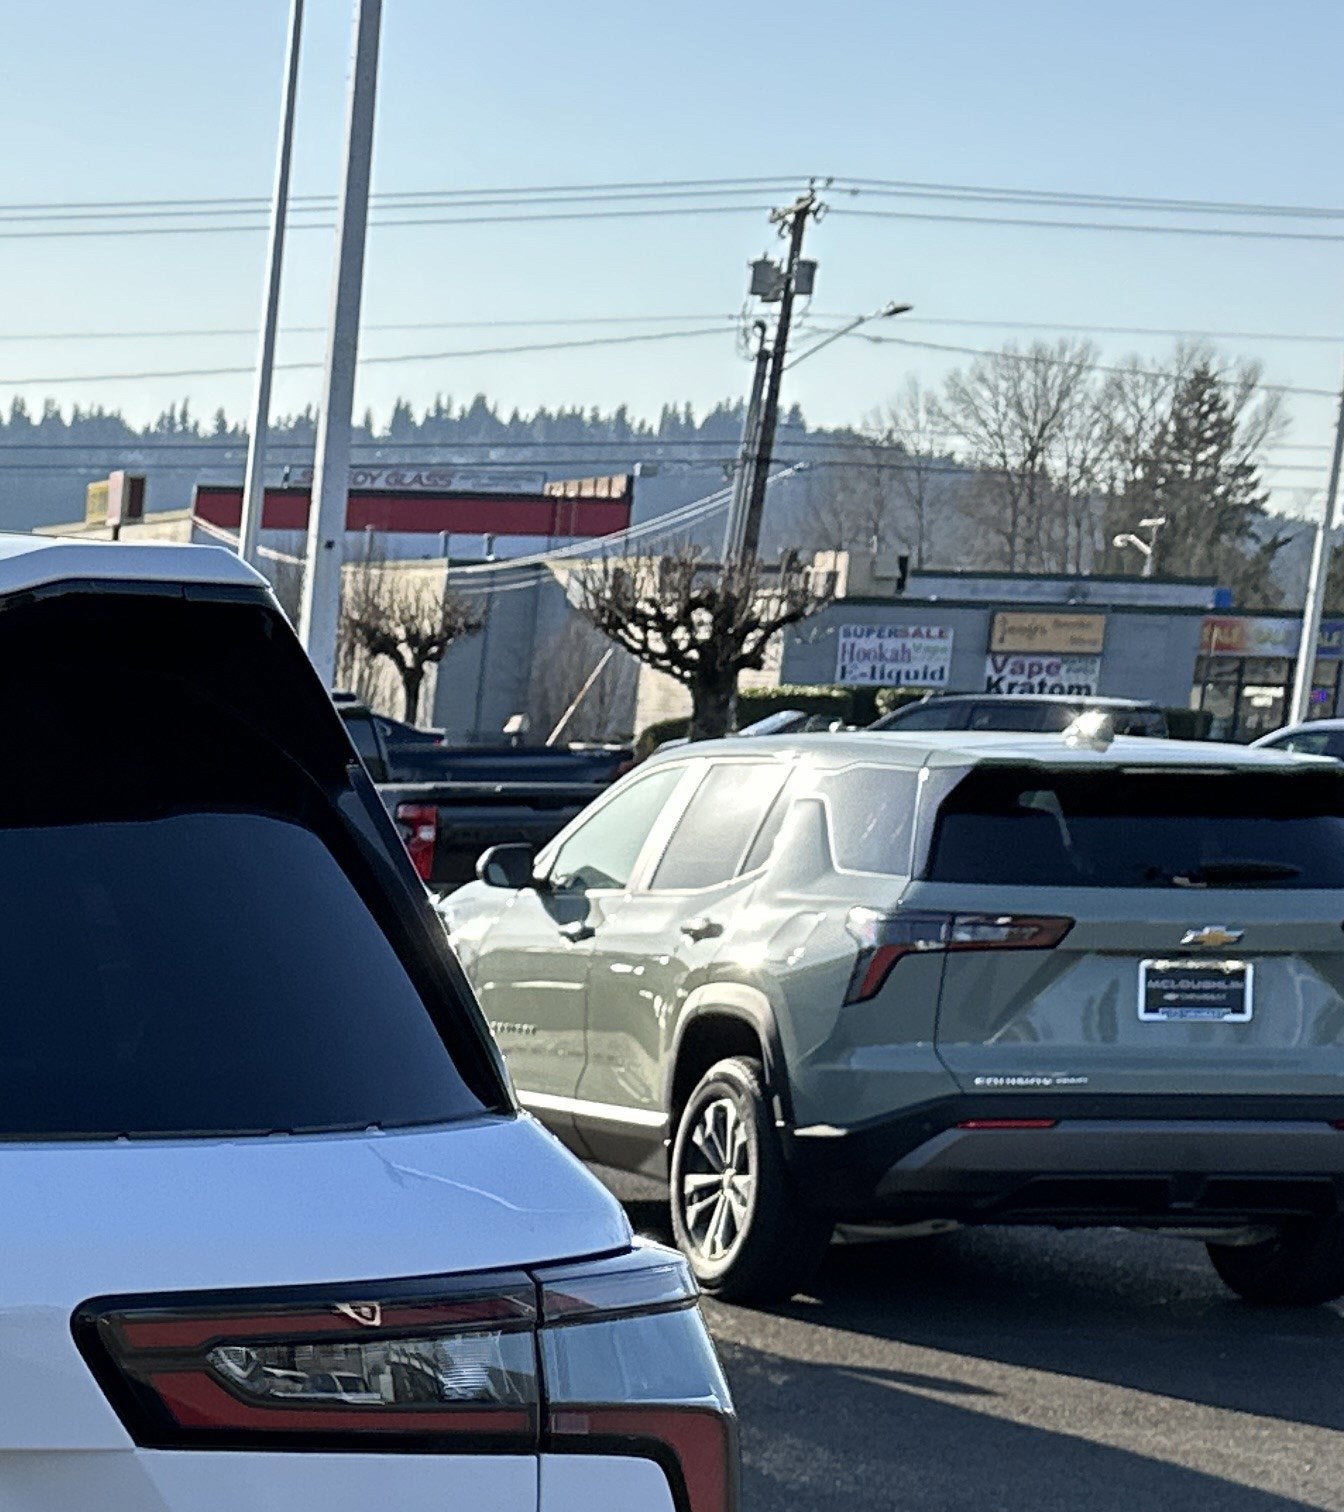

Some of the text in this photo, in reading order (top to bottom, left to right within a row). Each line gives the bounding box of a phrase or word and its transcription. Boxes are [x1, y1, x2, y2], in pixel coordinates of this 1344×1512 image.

[385, 470, 453, 488] GLASS
[841, 642, 911, 662] Hookah
[840, 665, 945, 685] E-liquid
[990, 655, 1062, 679] Vape
[985, 676, 1092, 695] Kratom
